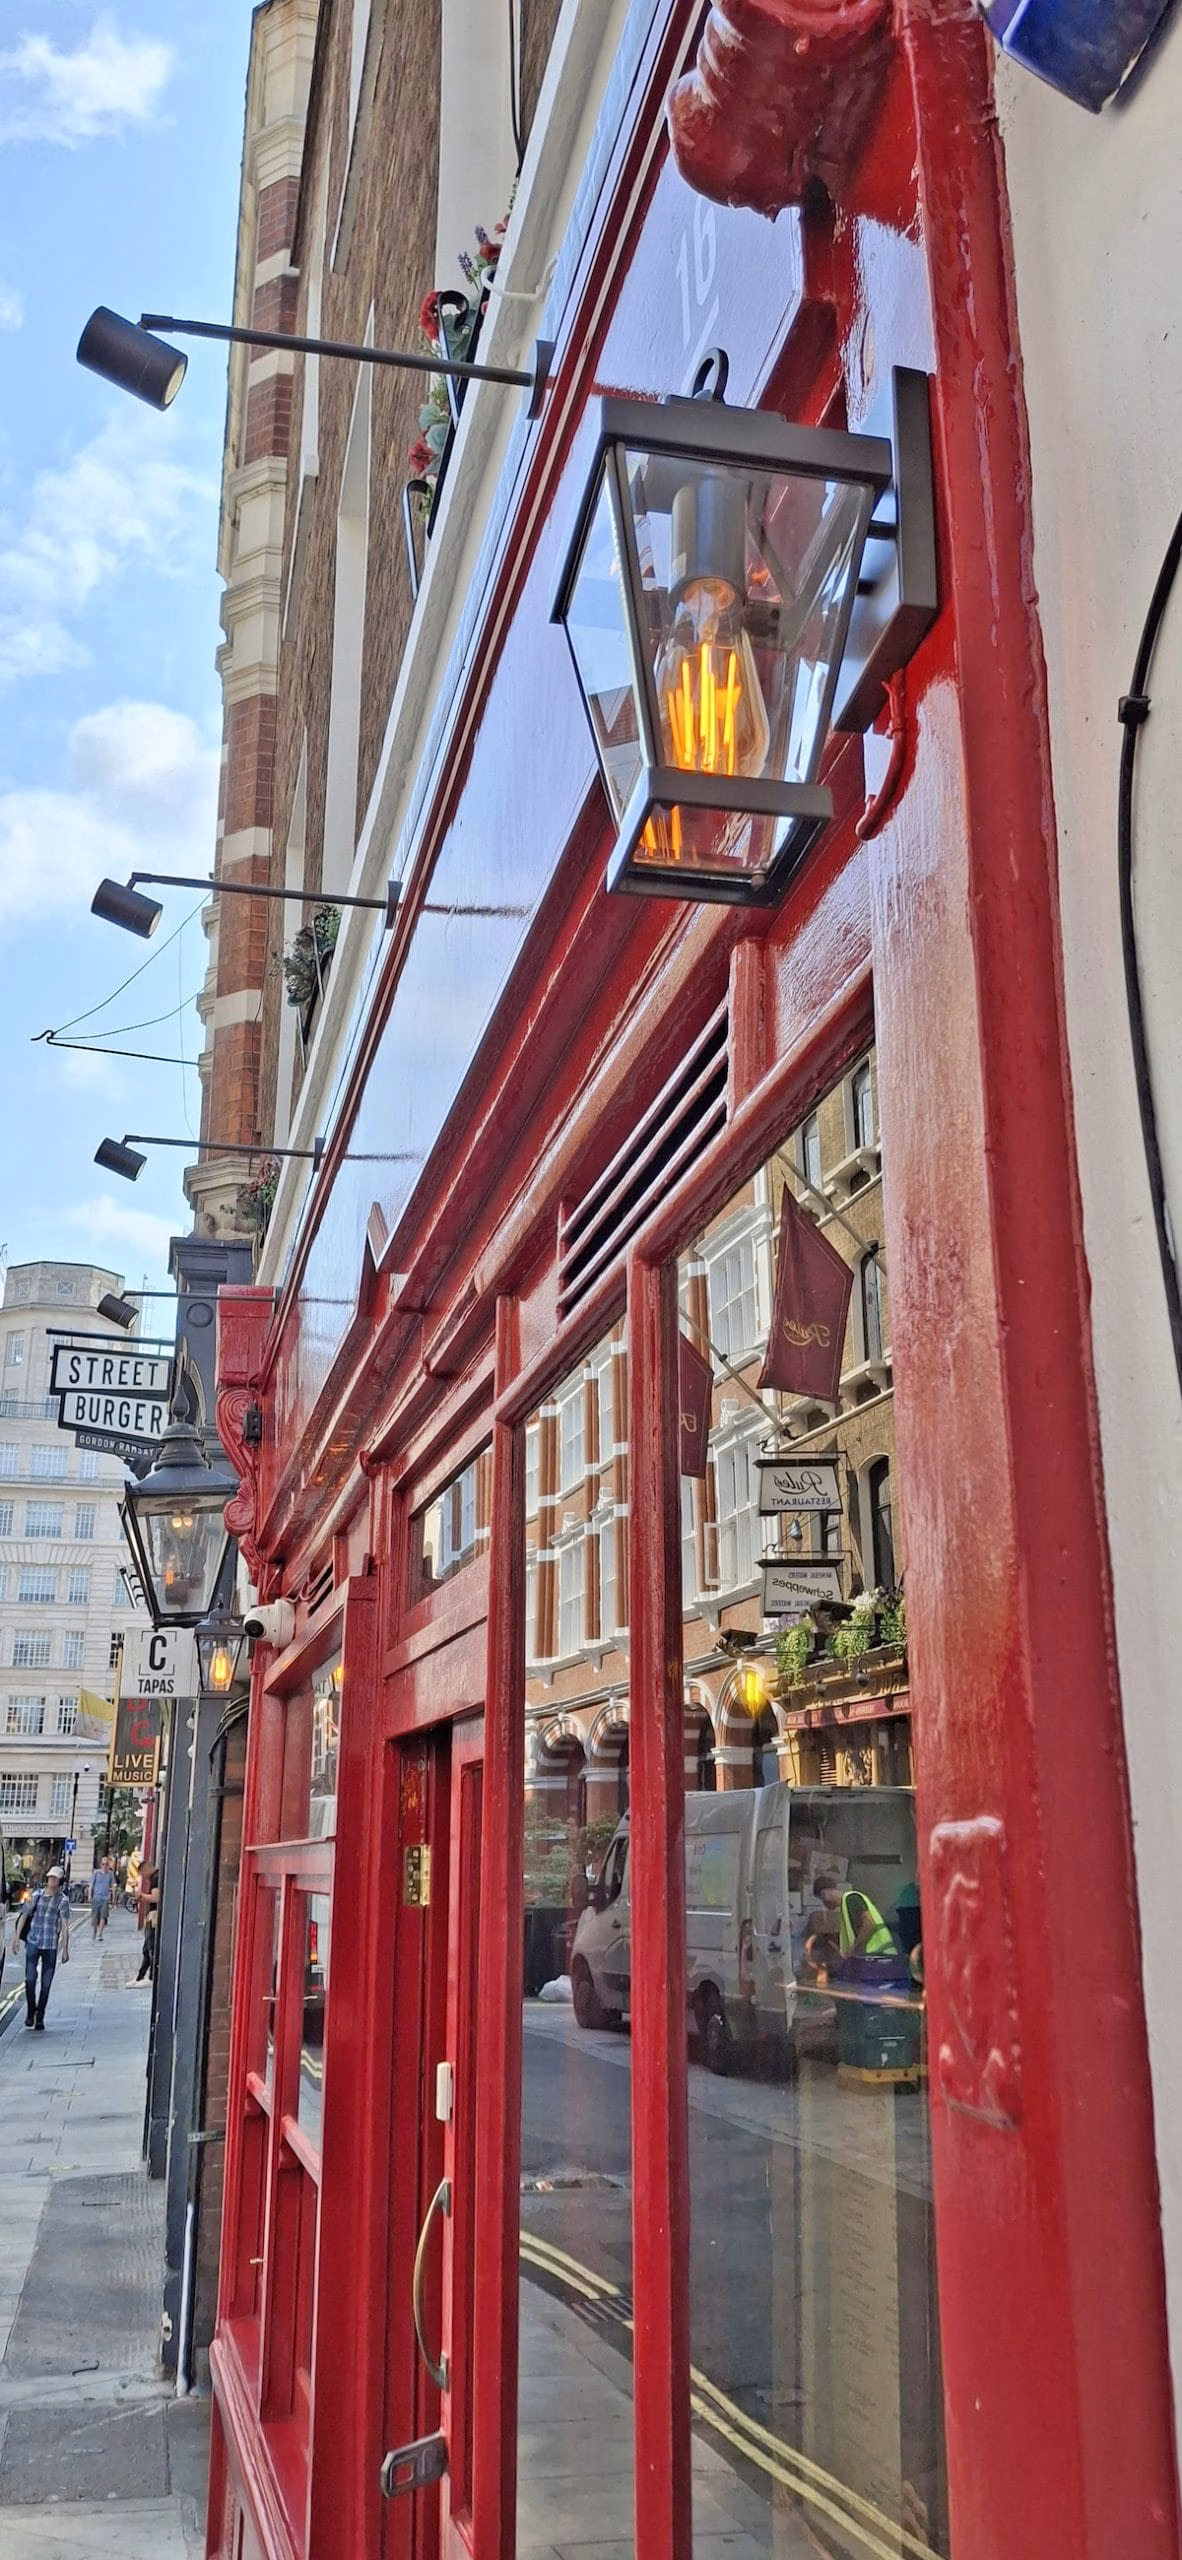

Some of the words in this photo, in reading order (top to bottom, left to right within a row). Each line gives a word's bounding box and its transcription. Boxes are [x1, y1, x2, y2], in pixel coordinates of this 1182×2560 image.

[69, 1356, 159, 1386] STREET
[75, 1395, 163, 1434] BURGER
[79, 1435, 115, 1449] GORDON
[119, 1442, 154, 1456] RAMSAY
[149, 1635, 167, 1671] C
[137, 1679, 174, 1694] TAPAS
[114, 1754, 154, 1768] LIVE
[113, 1771, 153, 1781] MUSIC
